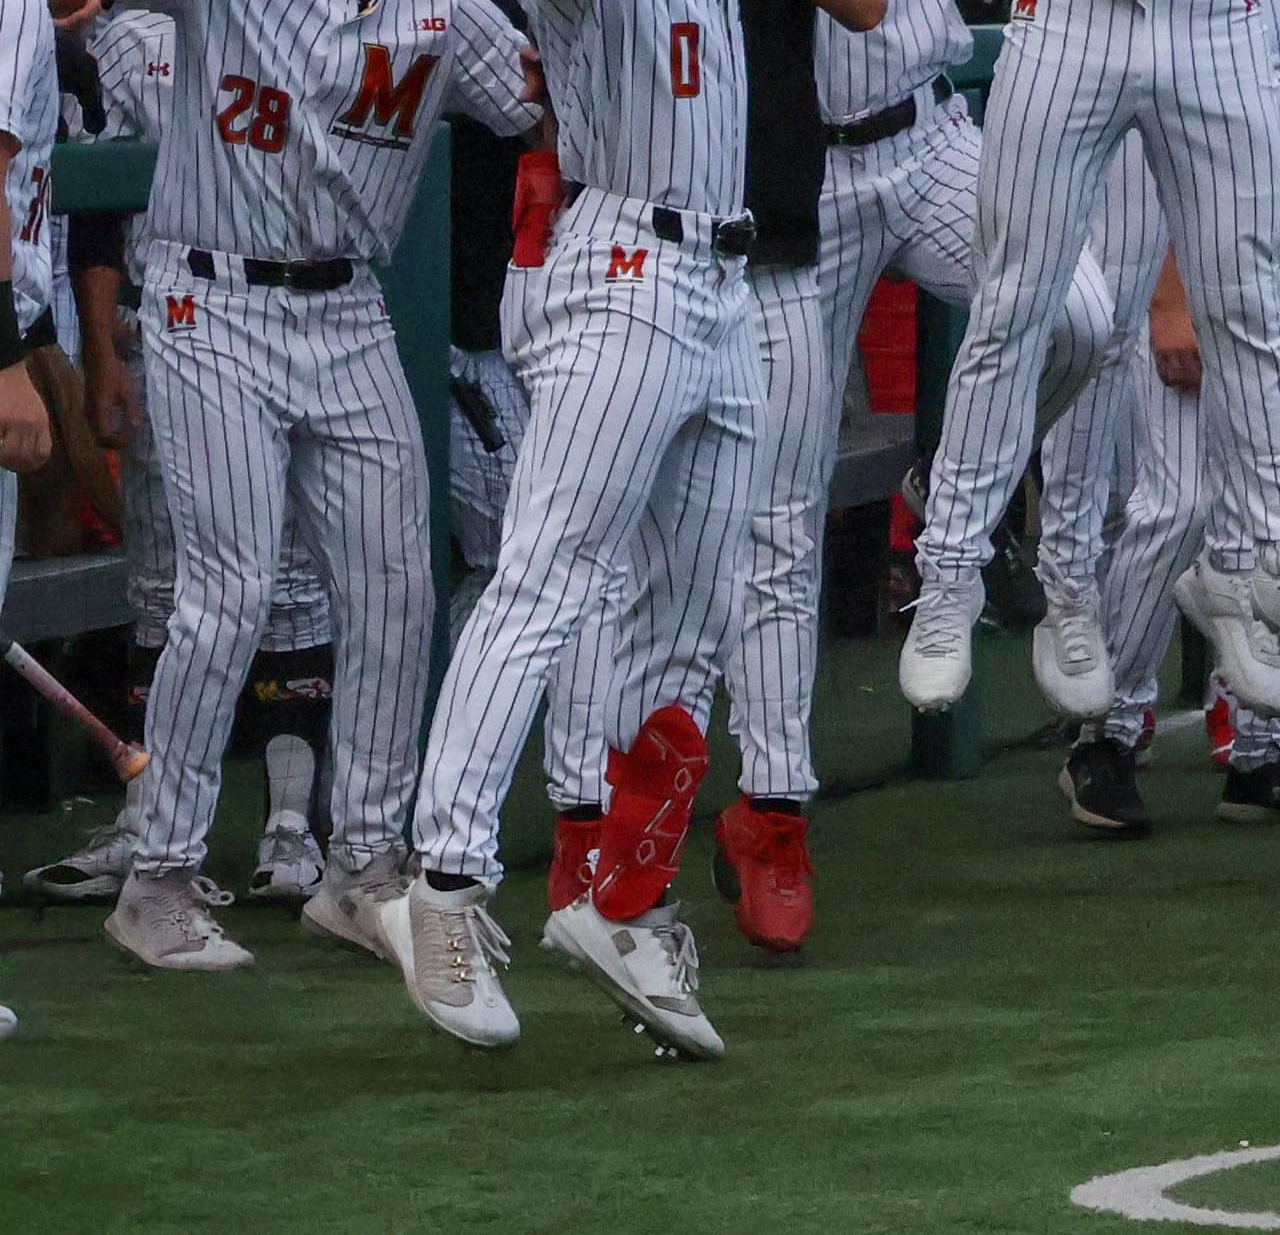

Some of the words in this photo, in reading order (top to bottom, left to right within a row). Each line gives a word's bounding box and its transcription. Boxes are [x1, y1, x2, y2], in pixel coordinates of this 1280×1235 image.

[335, 42, 442, 139] M
[670, 21, 701, 98] 0
[217, 74, 293, 154] 28
[605, 245, 644, 279] M
[166, 294, 196, 328] M
